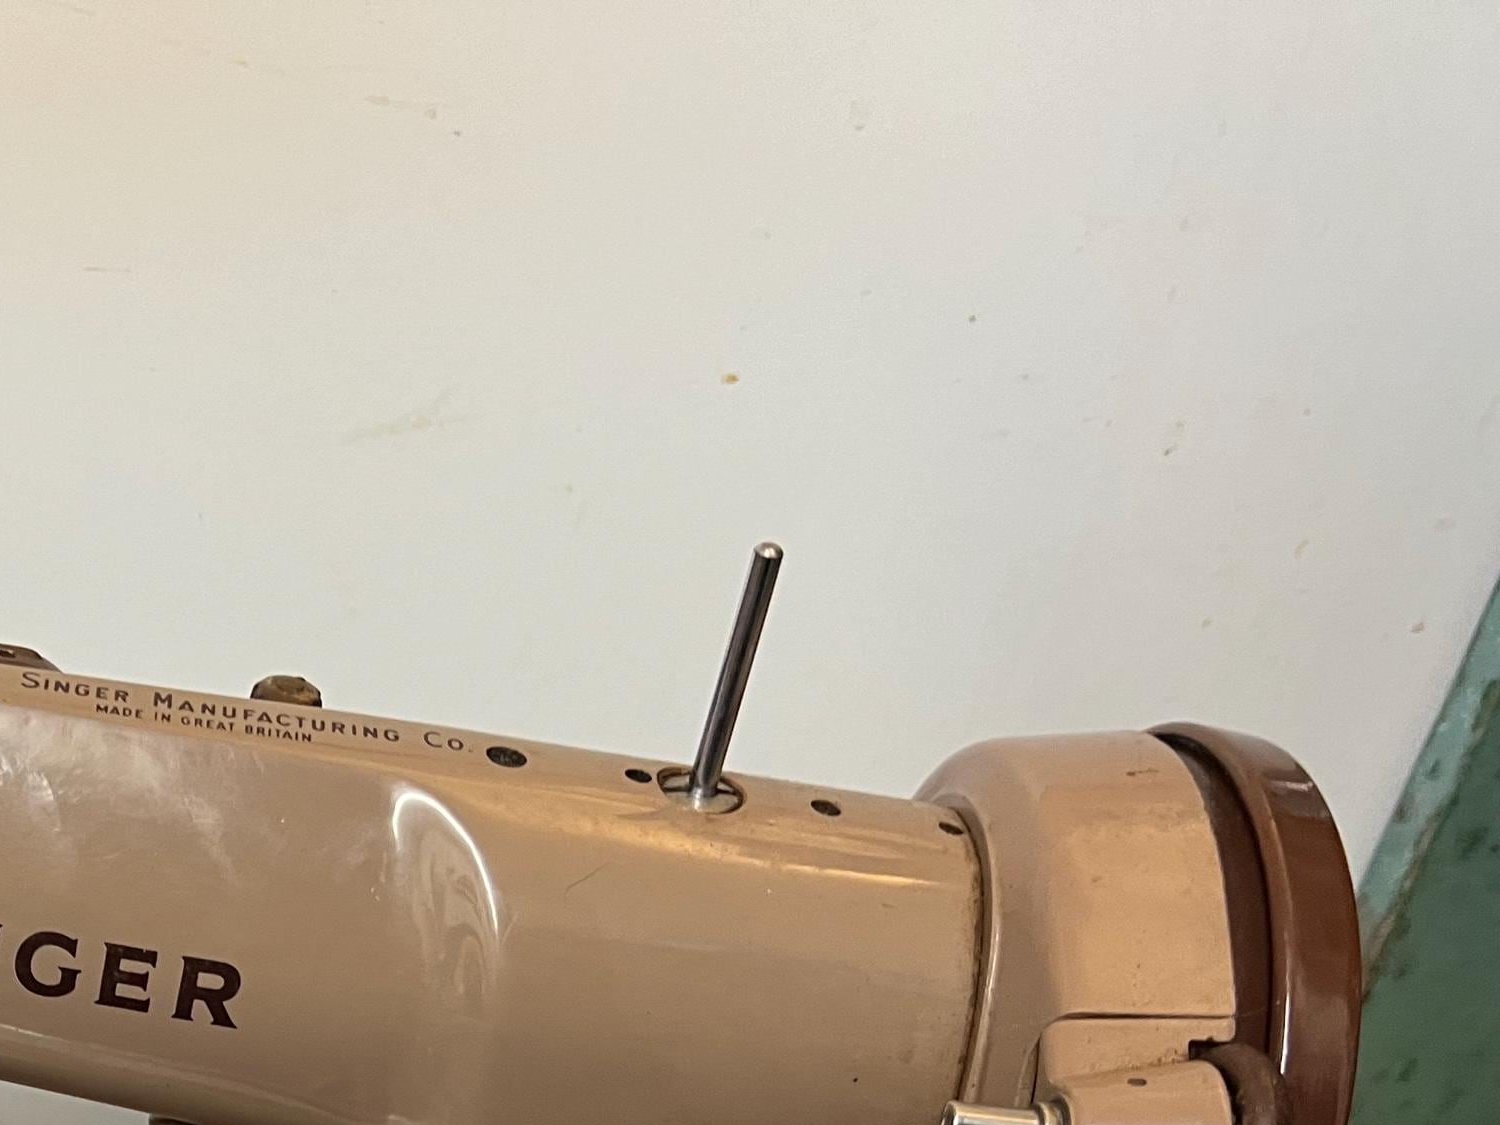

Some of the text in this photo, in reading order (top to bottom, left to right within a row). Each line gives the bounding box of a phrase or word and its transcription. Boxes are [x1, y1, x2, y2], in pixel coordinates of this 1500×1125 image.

[20, 670, 130, 703] SINGER
[152, 691, 400, 742] MANUFACTURING
[95, 703, 313, 743] MADE IN GREAT BRITAIN
